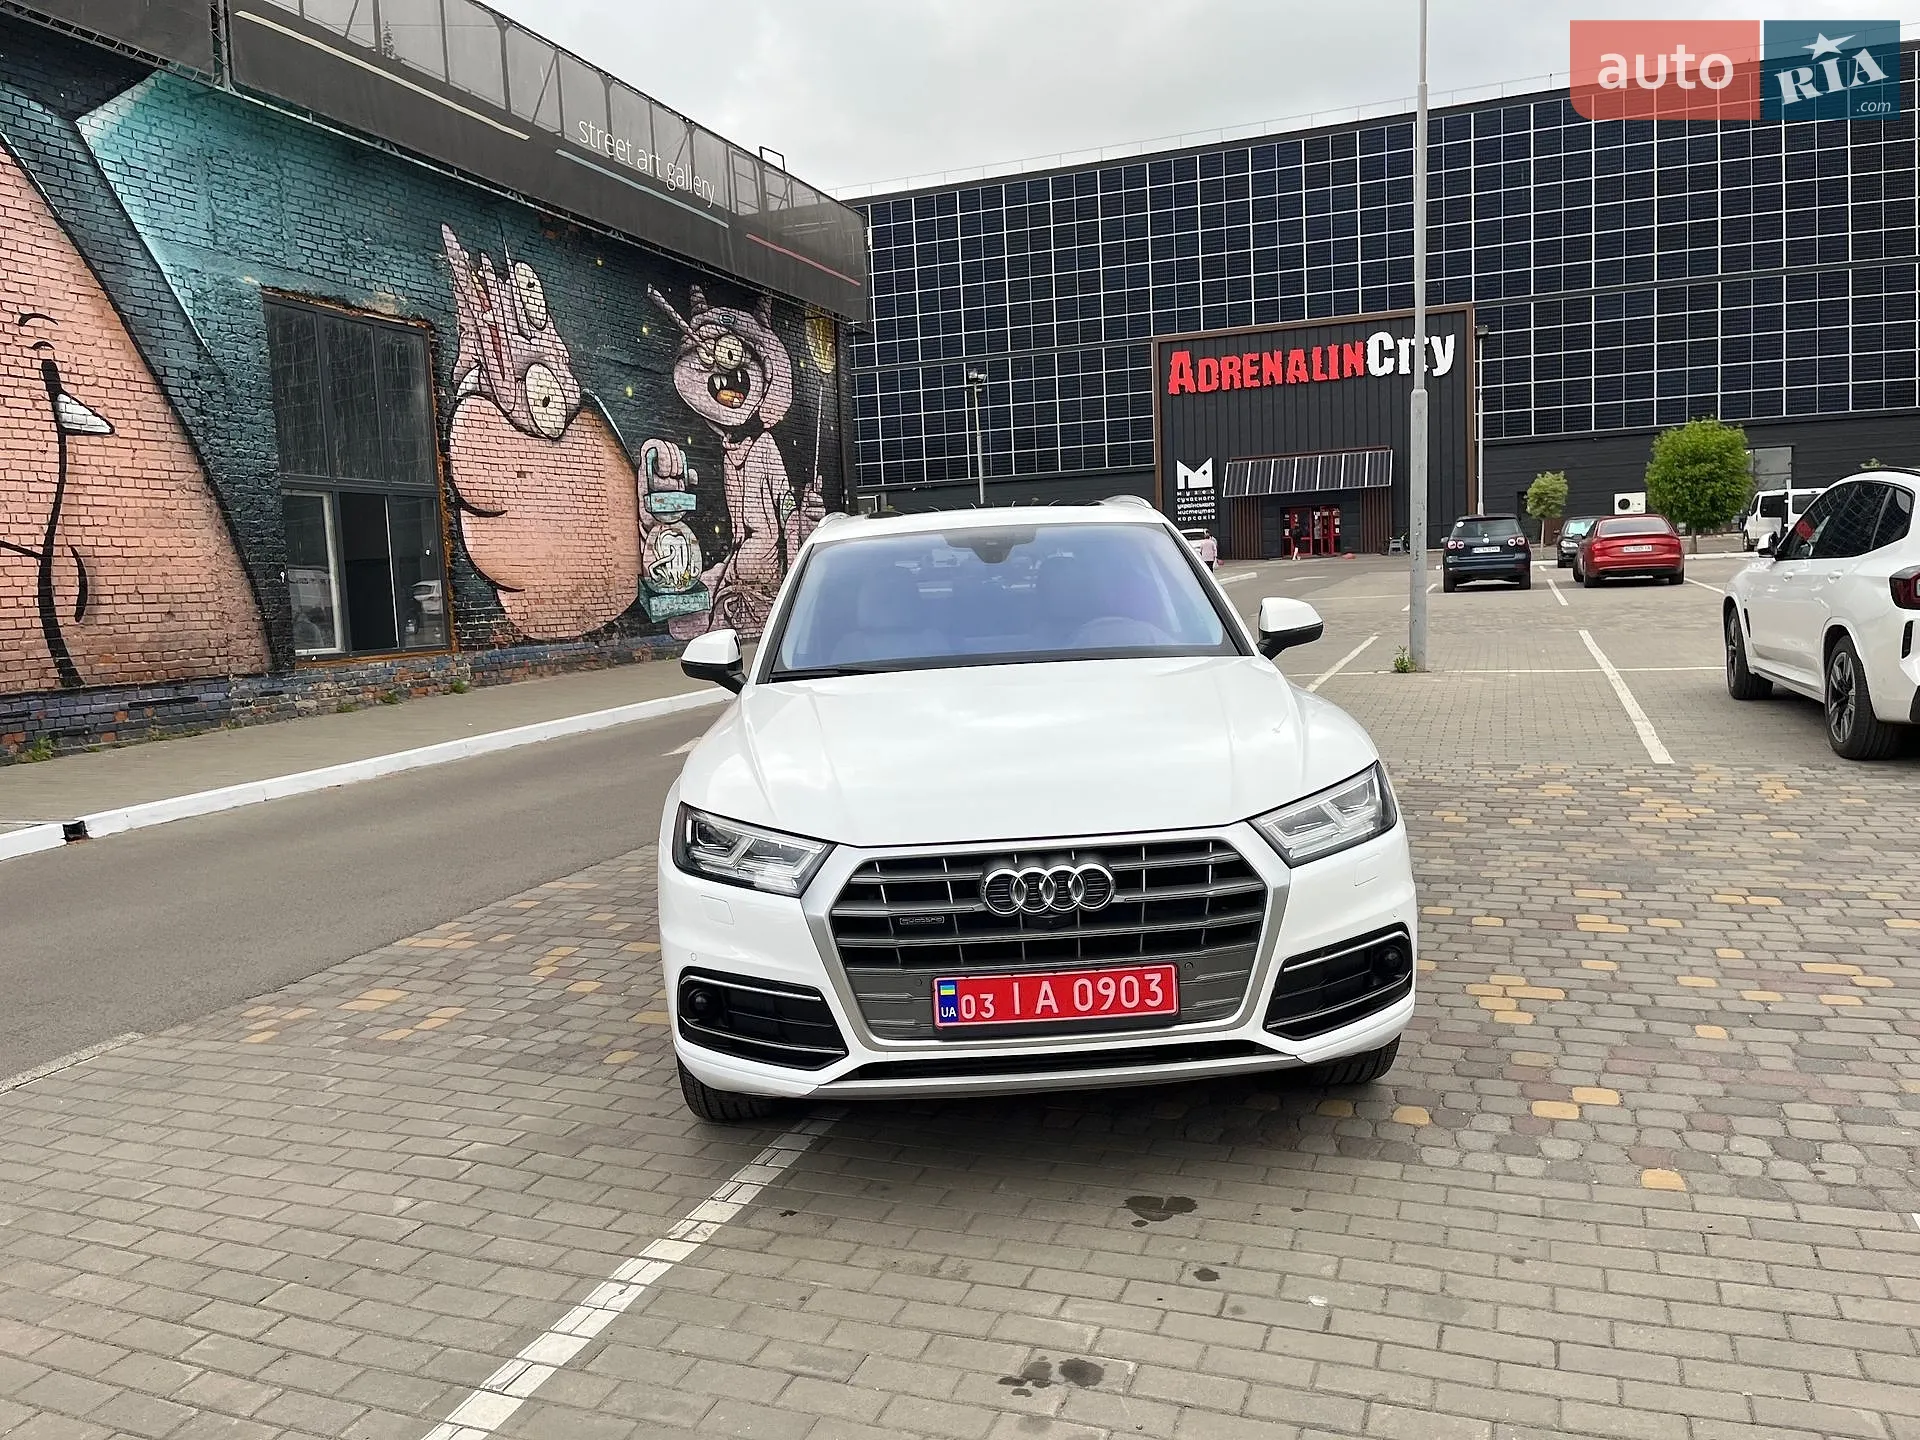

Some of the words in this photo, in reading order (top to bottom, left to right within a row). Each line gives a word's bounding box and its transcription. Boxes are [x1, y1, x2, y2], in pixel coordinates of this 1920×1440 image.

[578, 120, 635, 165] street
[637, 148, 662, 178] art
[666, 162, 715, 208] gallery
[941, 1006, 957, 1018] UA
[961, 993, 995, 1019] 03
[1073, 973, 1164, 1012] 0903
